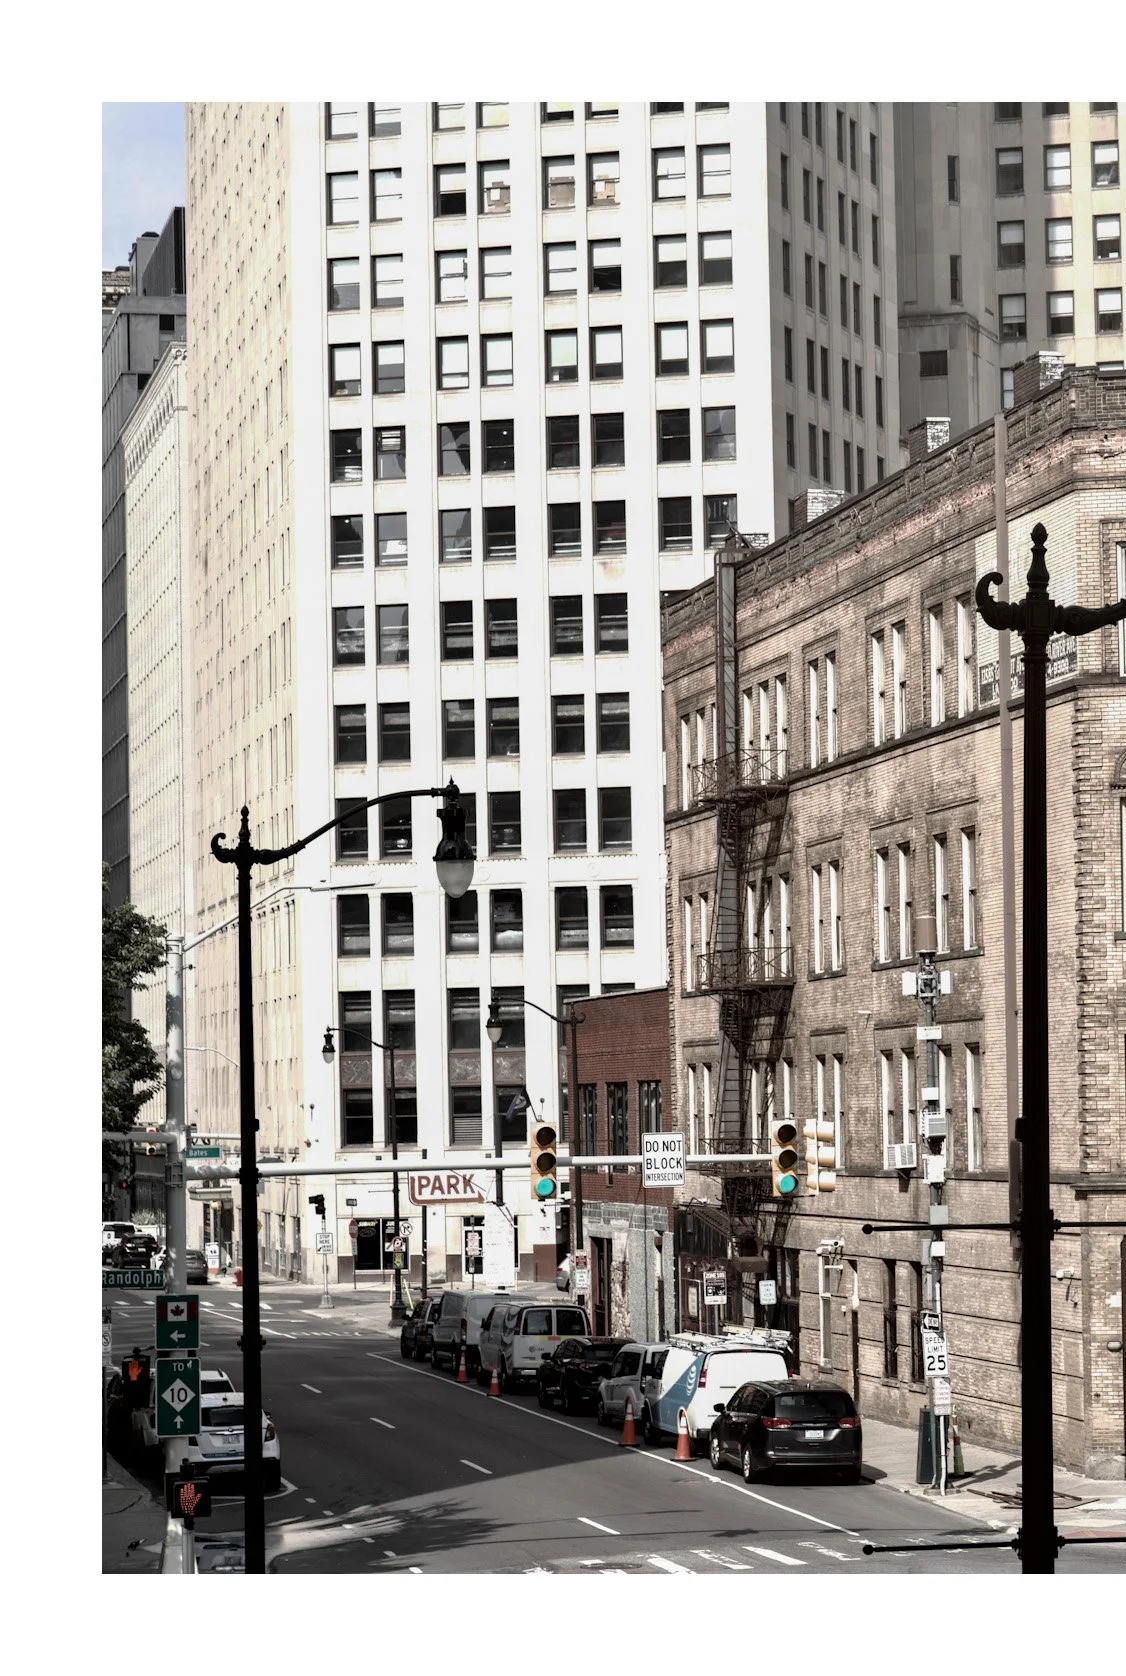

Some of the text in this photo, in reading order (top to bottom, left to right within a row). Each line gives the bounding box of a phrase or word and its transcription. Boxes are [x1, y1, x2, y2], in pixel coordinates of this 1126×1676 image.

[189, 1149, 208, 1157] Bates
[645, 1140, 682, 1153] DO NOT
[645, 1157, 683, 1170] BLOCK
[645, 1172, 683, 1182] INTERSECTION
[417, 1174, 475, 1196] PARK
[102, 1270, 161, 1287] Randolph
[925, 1336, 945, 1344] SPEED
[172, 1362, 184, 1371] TO
[927, 1355, 946, 1371] 25
[170, 1387, 187, 1403] 10
